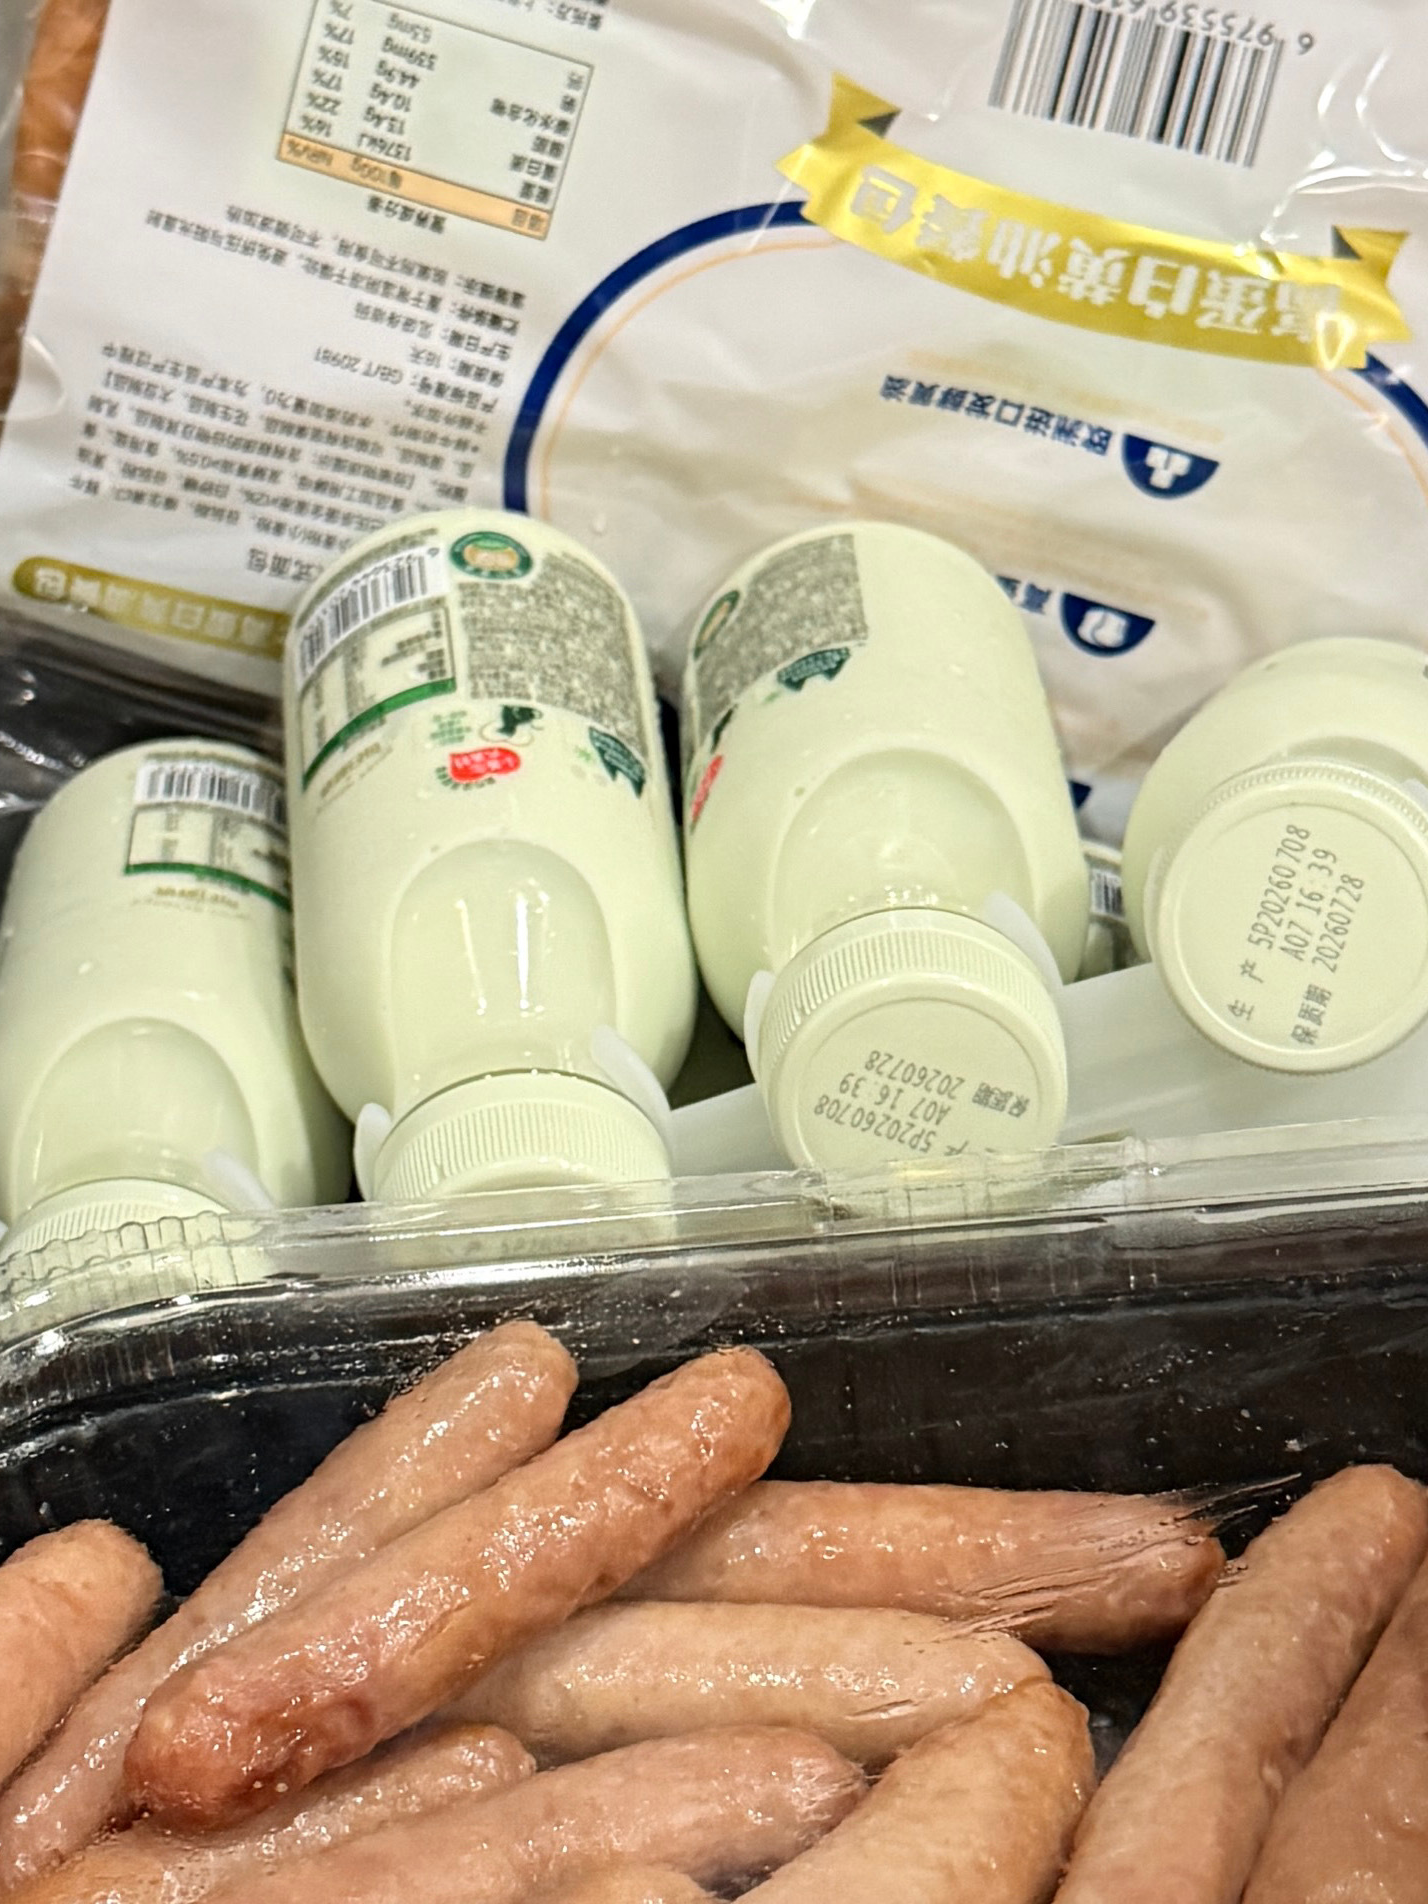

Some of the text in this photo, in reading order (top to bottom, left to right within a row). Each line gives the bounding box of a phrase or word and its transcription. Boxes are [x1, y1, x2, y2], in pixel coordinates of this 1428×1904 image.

[321, 21, 356, 46] 17%
[1294, 30, 1314, 56] 6
[309, 67, 344, 92] 17%
[373, 59, 422, 90] 44.9g
[298, 112, 334, 138] 16%
[304, 90, 559, 182] 蛋白质 13.4g 22%
[878, 372, 1113, 457] 欧洲进口发酵黄油
[1280, 920, 1313, 961] A07
[1290, 873, 1364, 1046] 保质期 20260728
[863, 1049, 1030, 1117] 保质期 20260728
[813, 1094, 936, 1152] 5P20260708
[909, 1098, 950, 1124] A07
